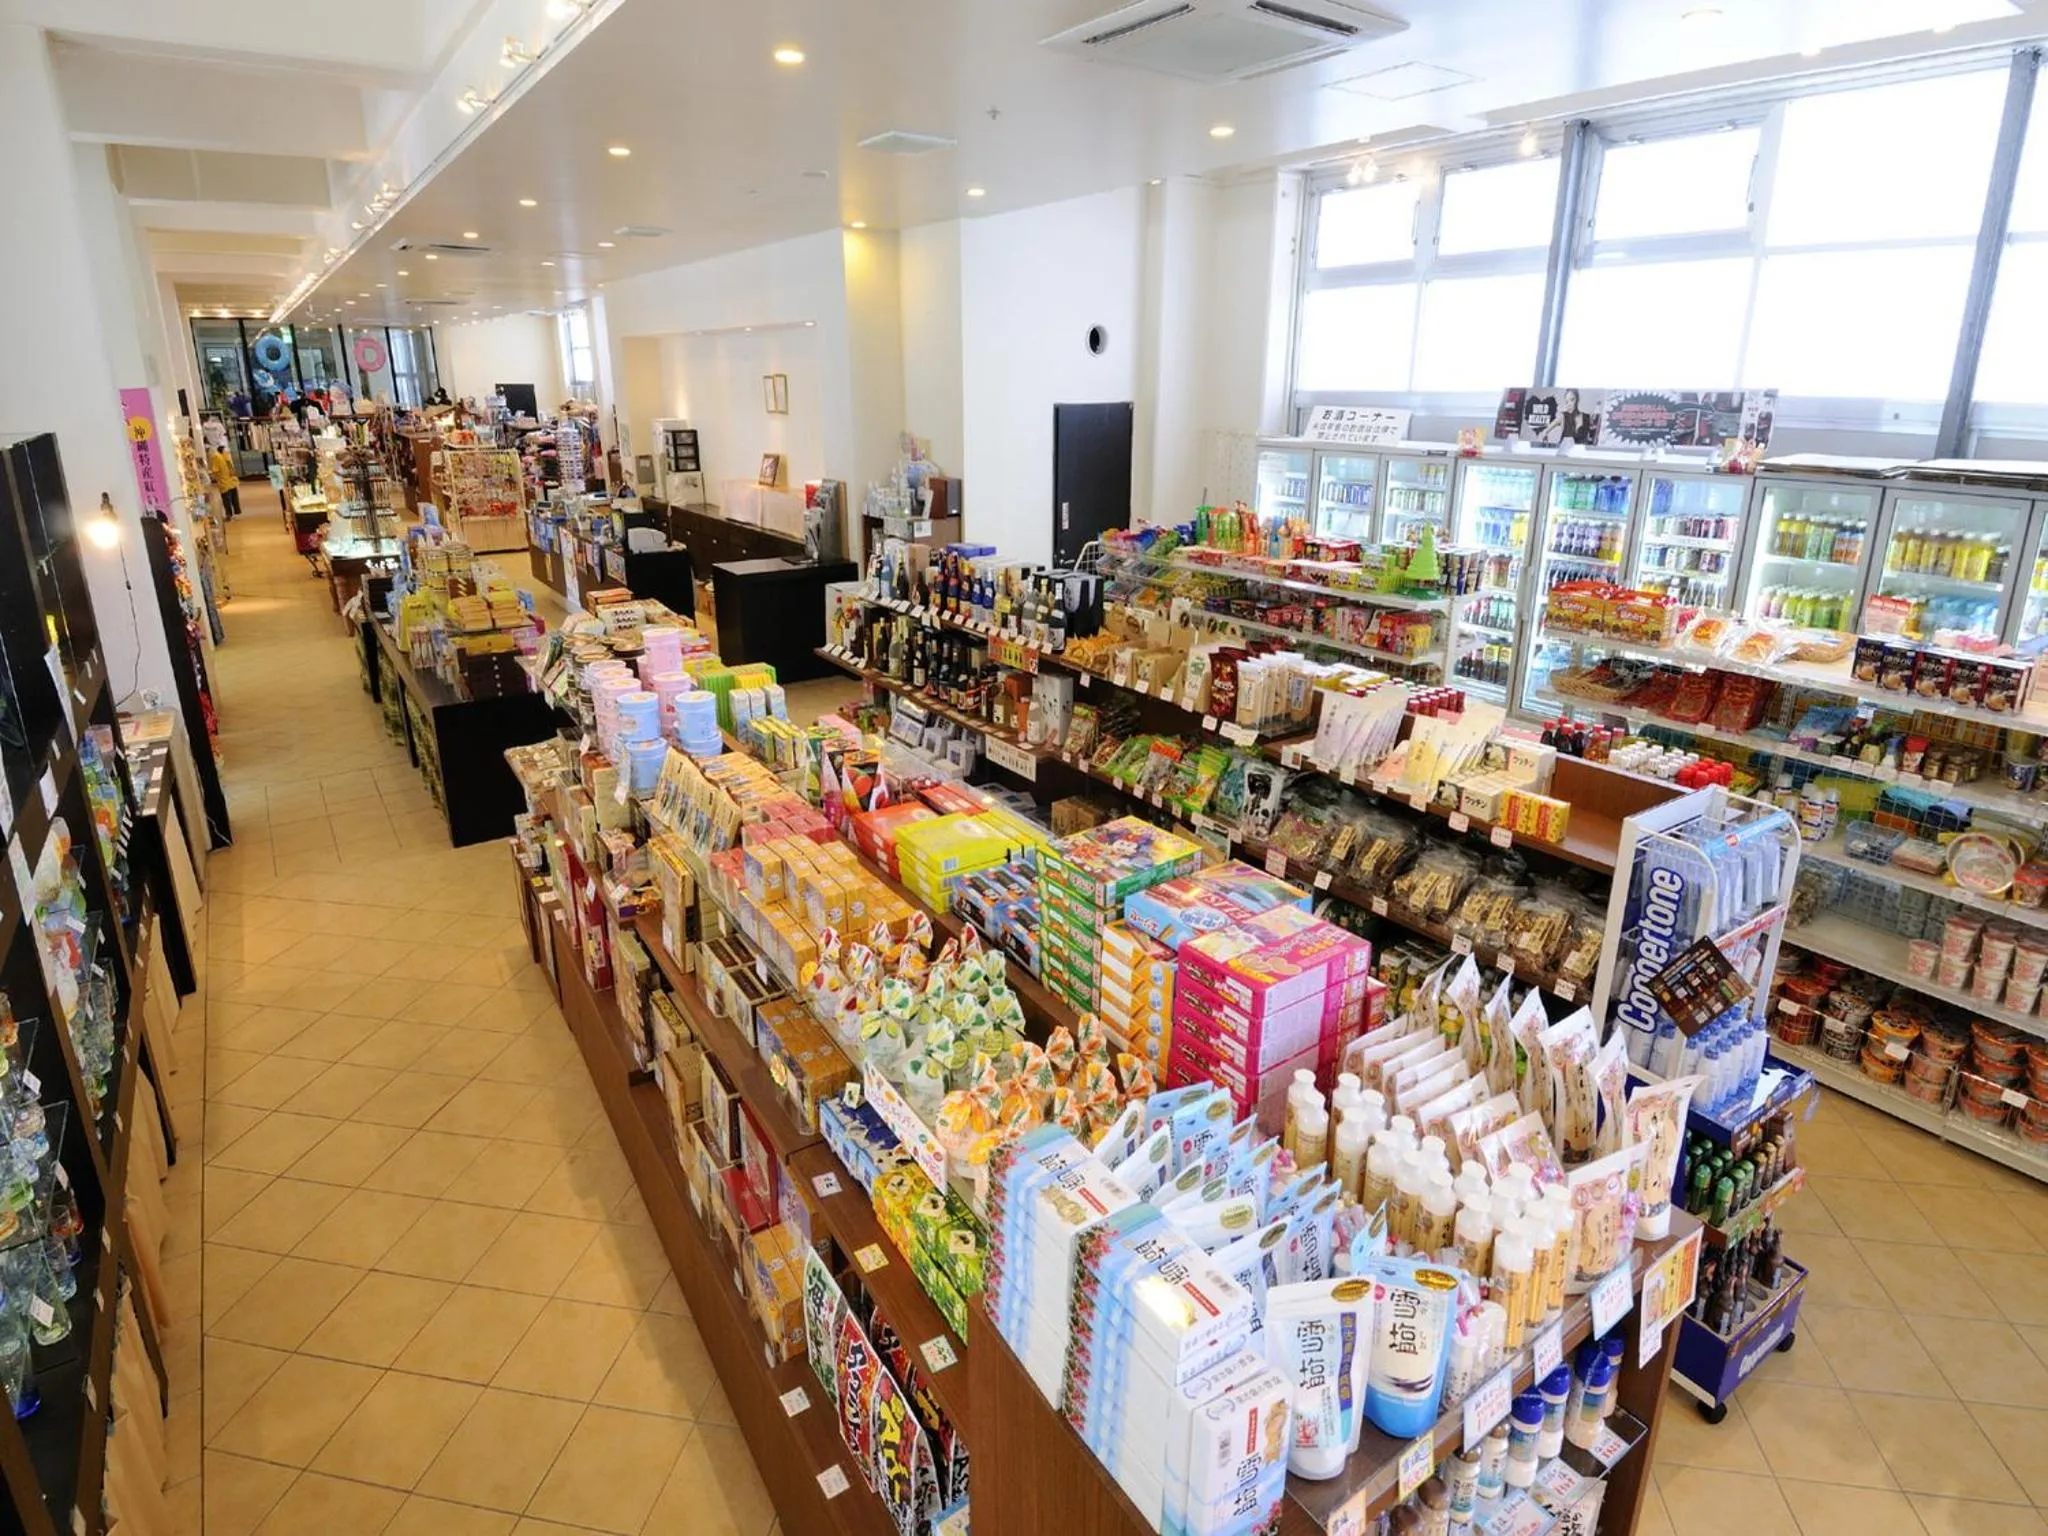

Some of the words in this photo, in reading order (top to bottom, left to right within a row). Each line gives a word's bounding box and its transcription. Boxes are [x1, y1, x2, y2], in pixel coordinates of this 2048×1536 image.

[1322, 409, 1395, 421] お酒コーナー
[1297, 1319, 1326, 1390] 雪塩
[1388, 1288, 1421, 1356] 雪塩
